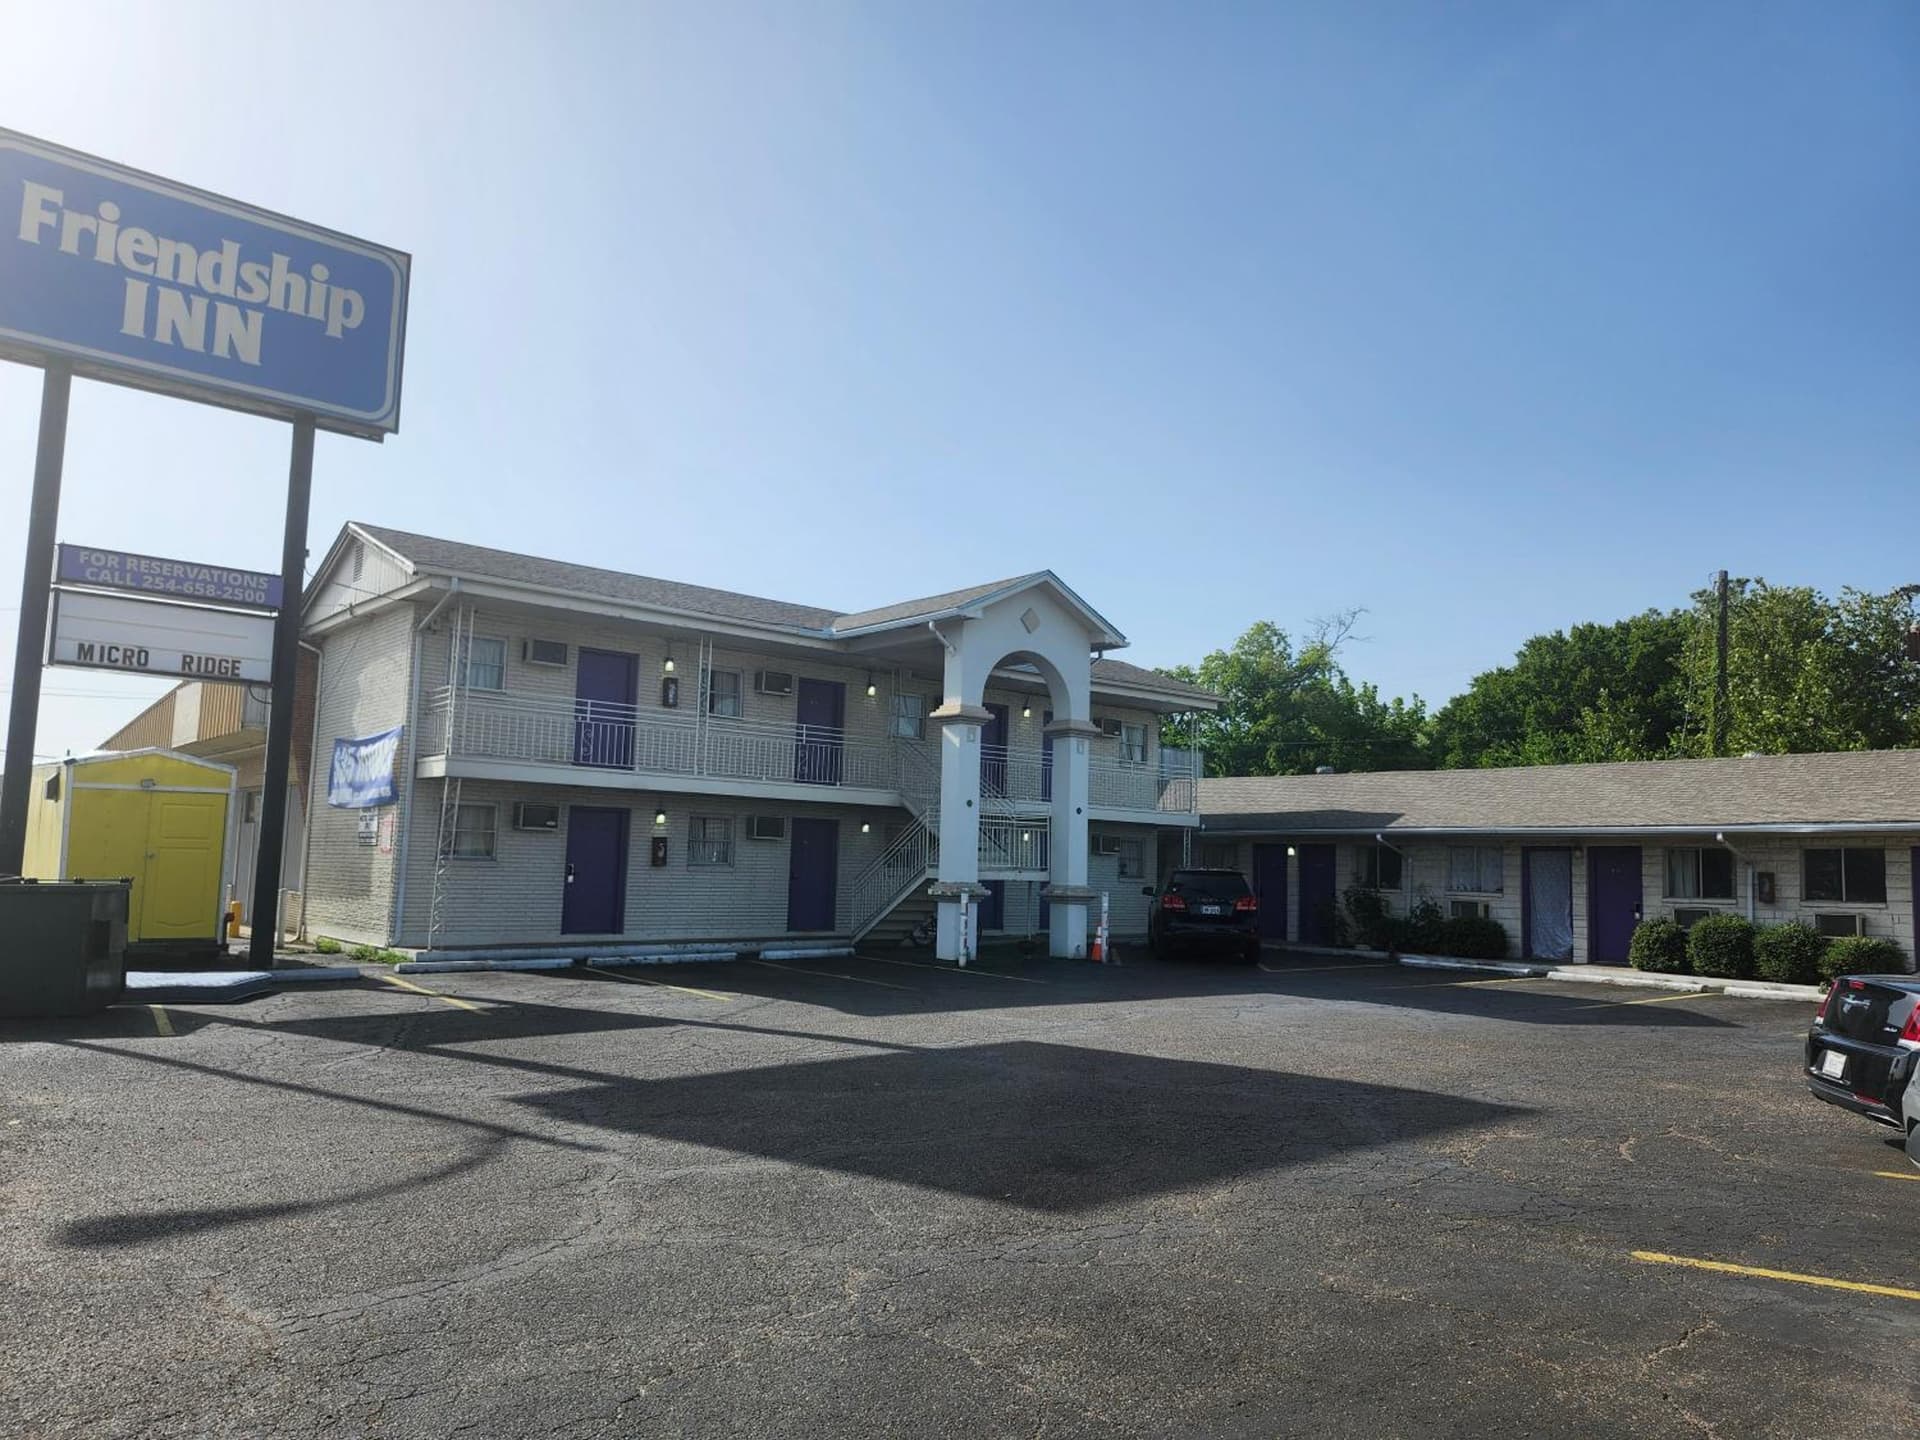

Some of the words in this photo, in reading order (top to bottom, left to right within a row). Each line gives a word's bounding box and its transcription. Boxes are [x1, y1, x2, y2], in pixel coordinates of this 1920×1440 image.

[18, 180, 365, 338] Friendship
[120, 276, 264, 366] INN
[80, 551, 119, 569] FOR
[126, 556, 269, 590] RESERVATIONS
[85, 567, 137, 587] CALL
[143, 575, 265, 604] 254-658-2500
[77, 642, 150, 667] MICRO
[181, 654, 242, 677] RIDGE
